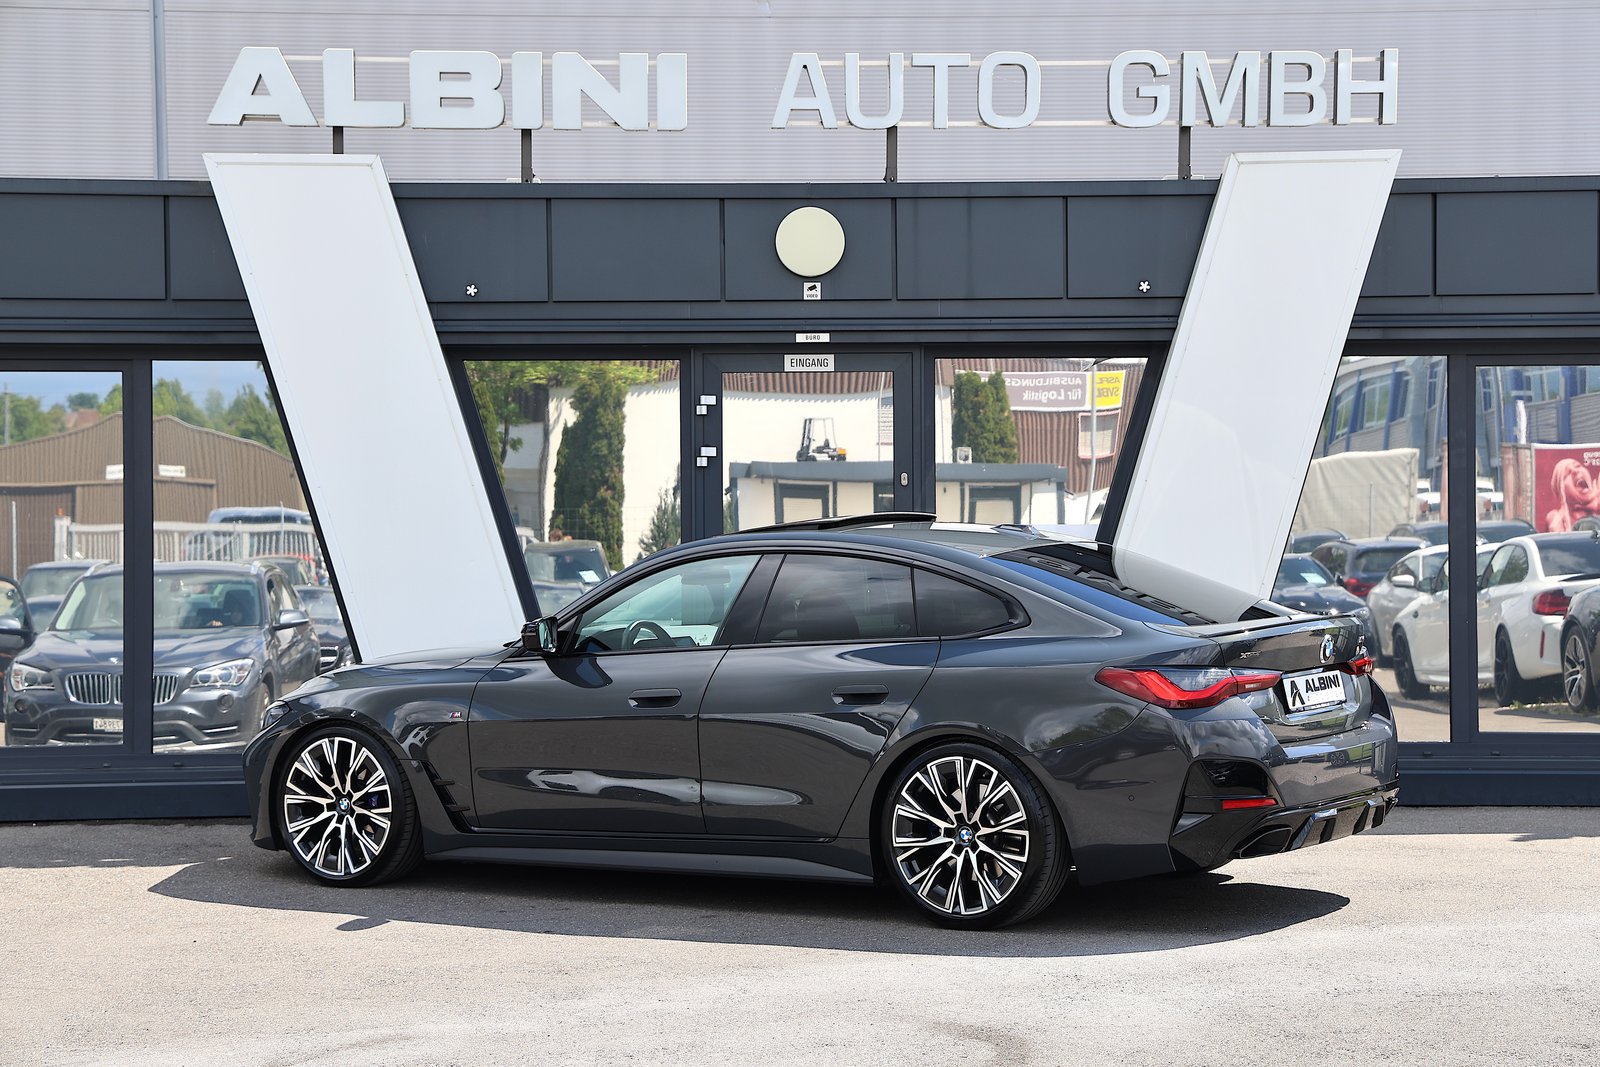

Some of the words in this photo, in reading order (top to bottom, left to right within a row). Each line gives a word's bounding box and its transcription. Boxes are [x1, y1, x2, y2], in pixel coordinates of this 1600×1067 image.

[207, 46, 688, 131] ALBINI
[771, 51, 1042, 130] AUTO
[1107, 48, 1399, 128] GMBH
[790, 357, 829, 368] EINGANG
[1305, 673, 1341, 694] ALBINI
